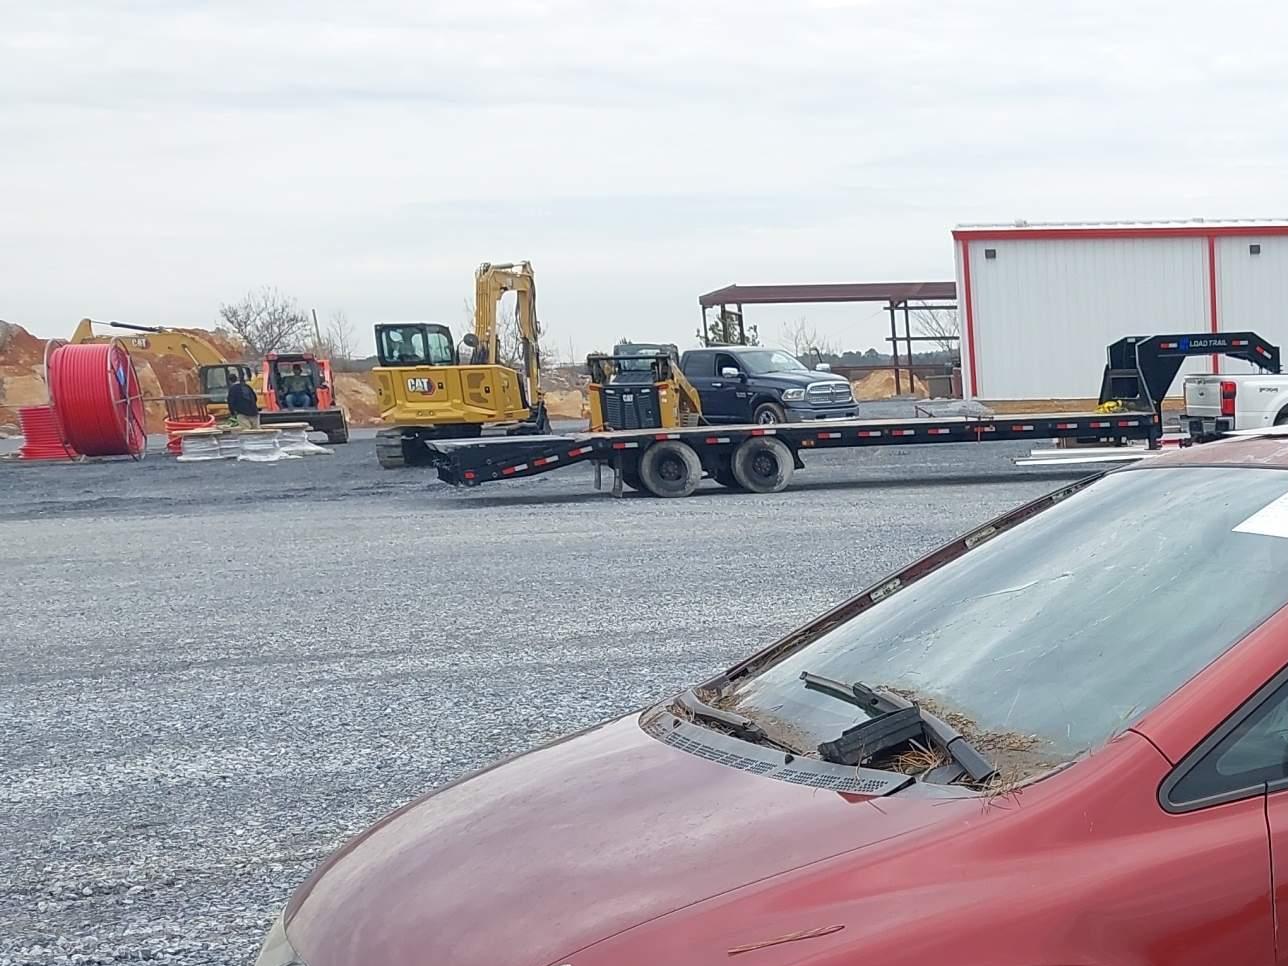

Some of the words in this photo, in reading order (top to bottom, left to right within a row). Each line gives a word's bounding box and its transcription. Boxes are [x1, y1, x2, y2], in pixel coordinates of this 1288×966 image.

[1189, 340, 1208, 348] LOAD
[1209, 339, 1228, 347] TRAIL
[407, 378, 429, 392] CAT
